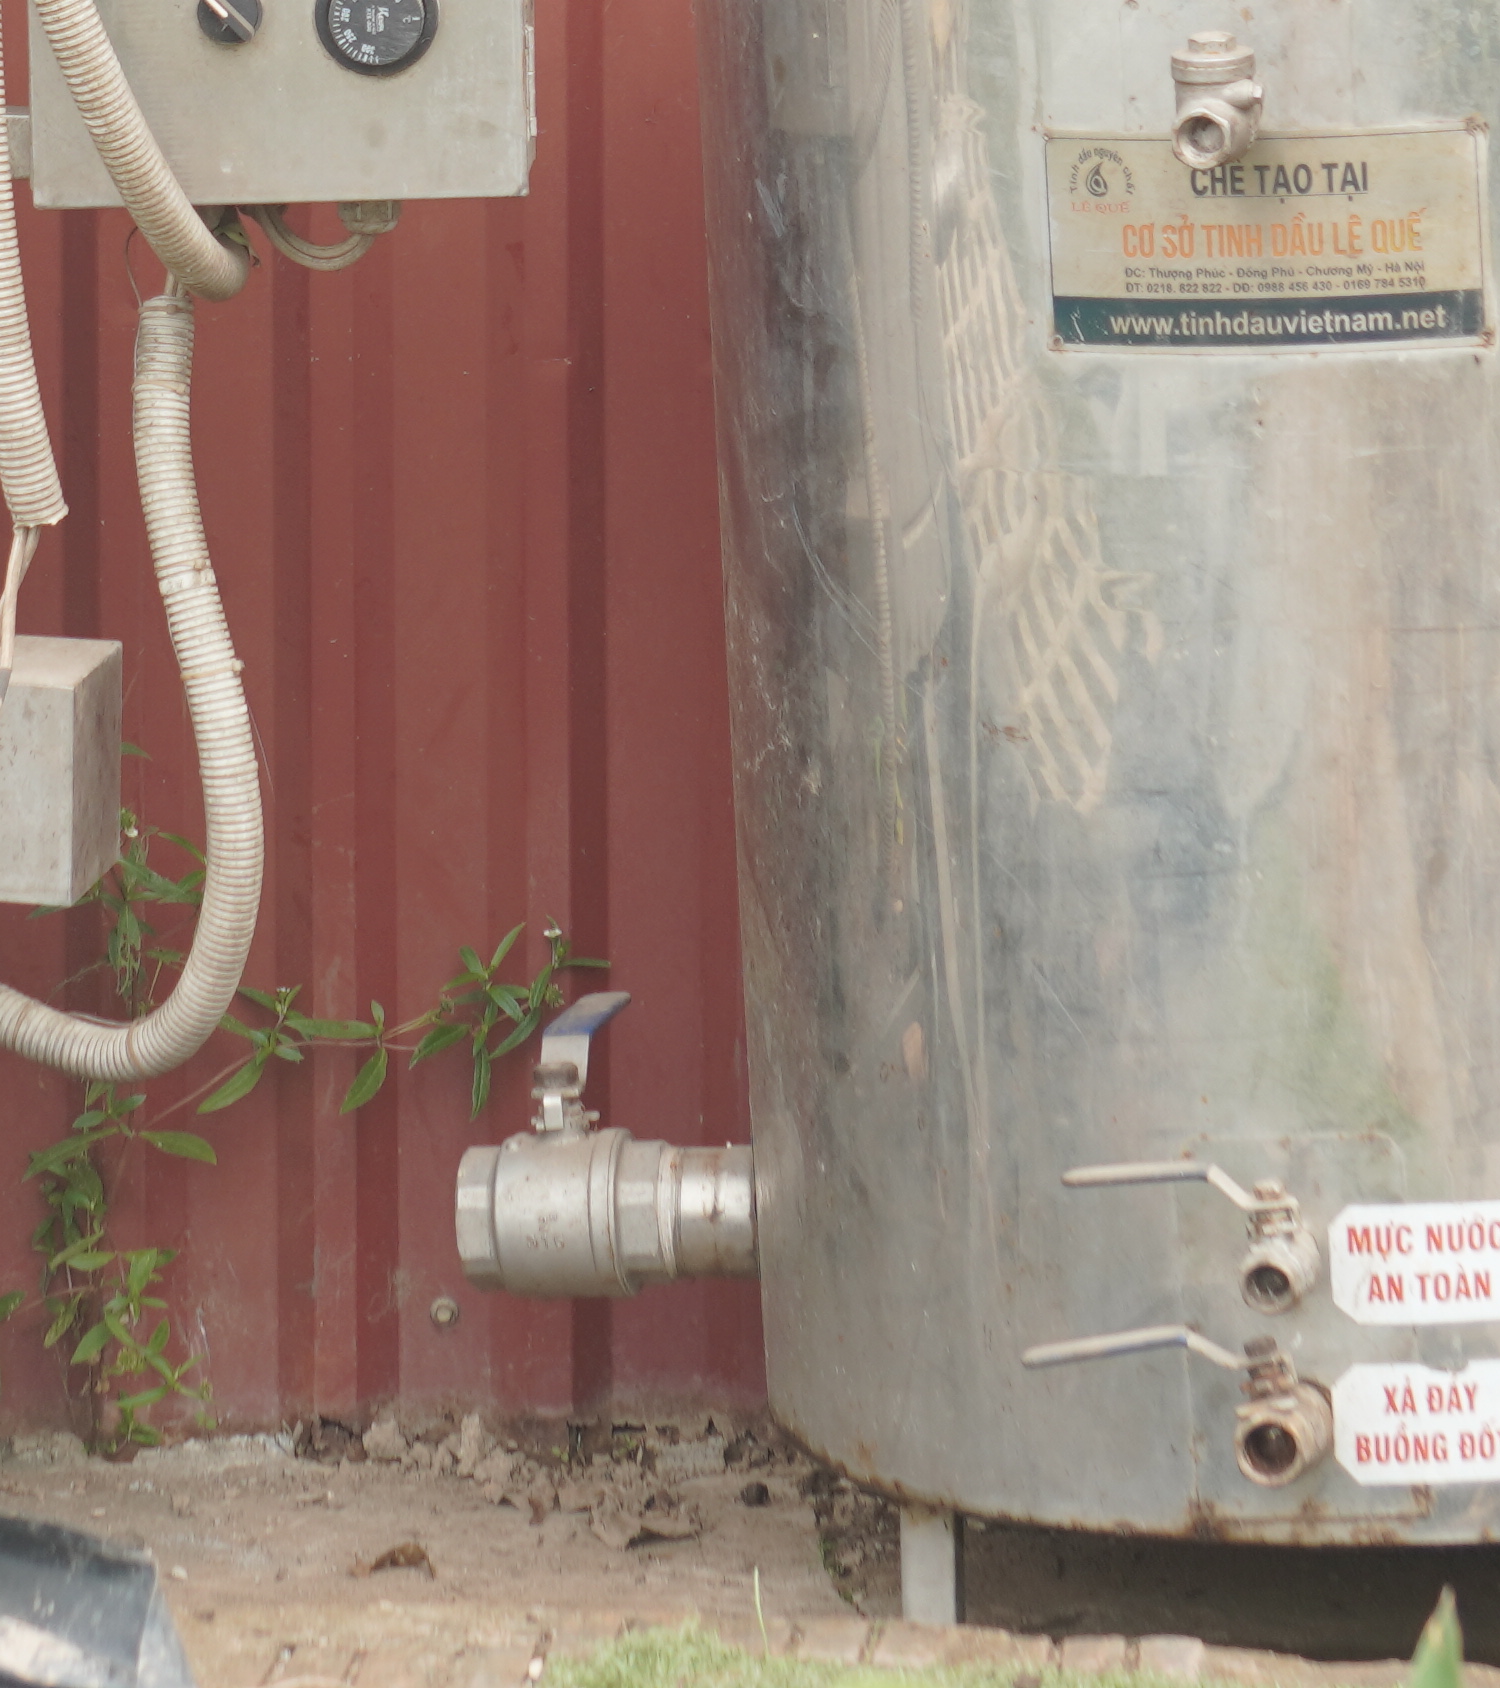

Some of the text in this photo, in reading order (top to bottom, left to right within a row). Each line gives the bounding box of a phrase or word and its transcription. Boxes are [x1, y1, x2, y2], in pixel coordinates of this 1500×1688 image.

[1254, 163, 1313, 205] TẠO
[1321, 161, 1369, 202] TẠI
[1122, 207, 1427, 259] CƠ SỞ TINH DẦU LÊ QUẾ
[1148, 267, 1193, 281] Thượng
[1306, 266, 1353, 278] Chương
[1202, 283, 1222, 293] 822
[1312, 281, 1332, 291] 430
[1374, 278, 1395, 289] 784
[1110, 304, 1447, 336] www.tinhdauvietnam.net
[1347, 1220, 1413, 1263] MỰC
[1367, 1262, 1492, 1304] AN TOÀN
[1383, 1374, 1418, 1416] XẢ
[1355, 1420, 1449, 1466] BUỒNG
